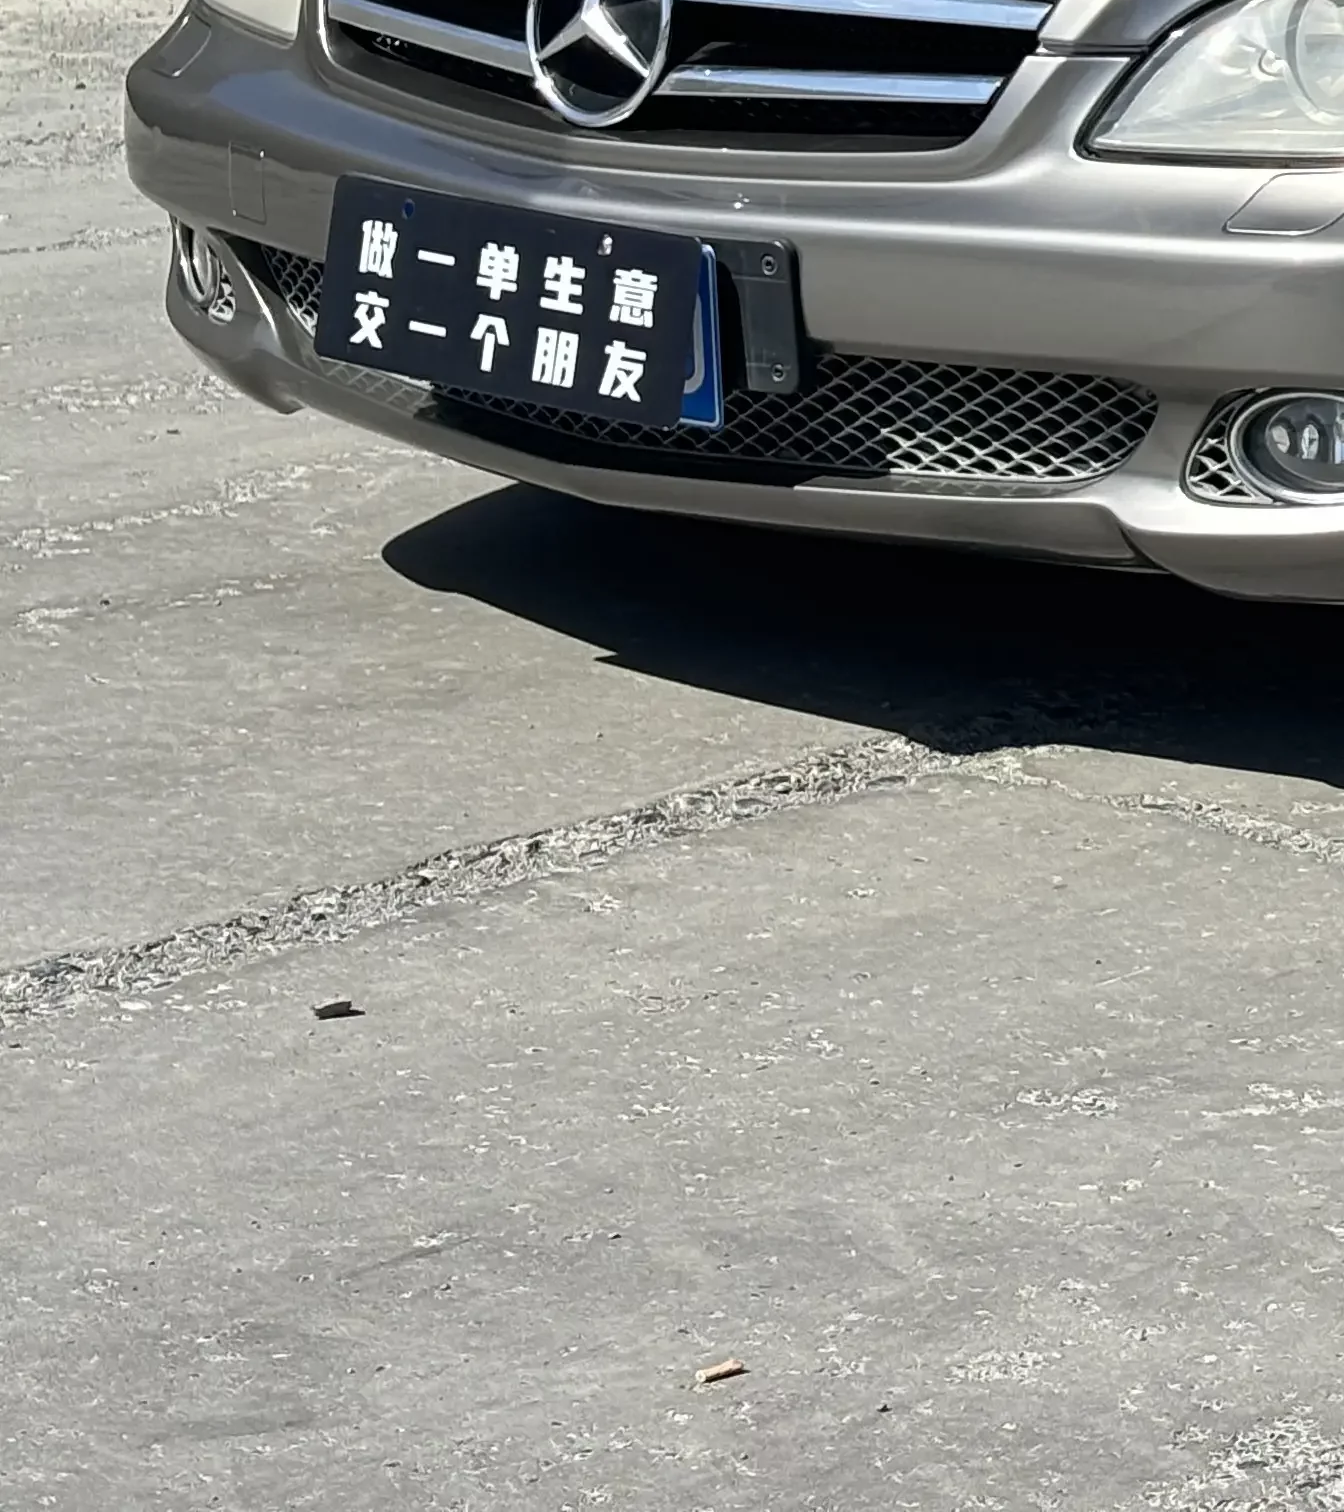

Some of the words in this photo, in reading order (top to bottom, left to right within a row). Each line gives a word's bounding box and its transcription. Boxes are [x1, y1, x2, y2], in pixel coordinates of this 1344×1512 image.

[357, 219, 658, 328] 做一单生意
[349, 290, 647, 403] 交一个朋友
